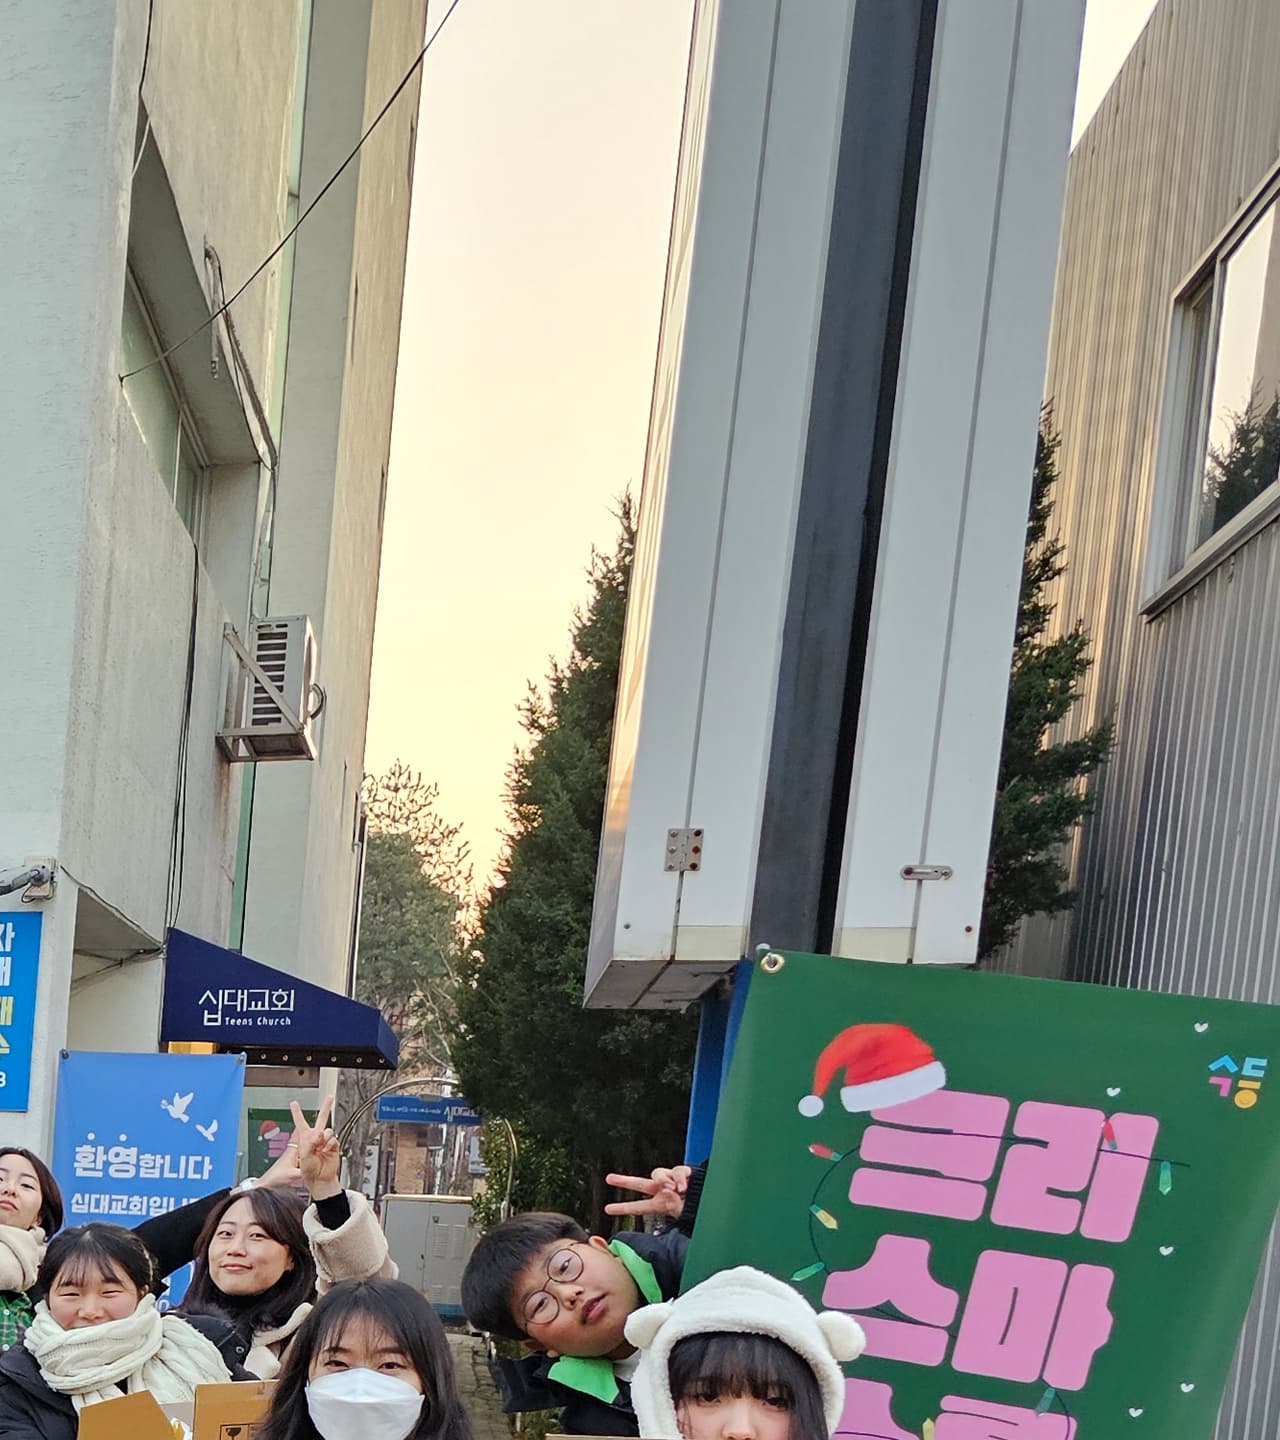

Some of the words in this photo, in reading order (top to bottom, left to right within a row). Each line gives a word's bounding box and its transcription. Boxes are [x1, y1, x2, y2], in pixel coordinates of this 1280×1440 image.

[198, 988, 295, 1026] 십대교회
[225, 1016, 253, 1026] Teens
[257, 1016, 292, 1026] Church
[73, 1144, 213, 1181] 환영합니다
[71, 1192, 200, 1217] 십대교회입니
[822, 1233, 1114, 1391] 스마
